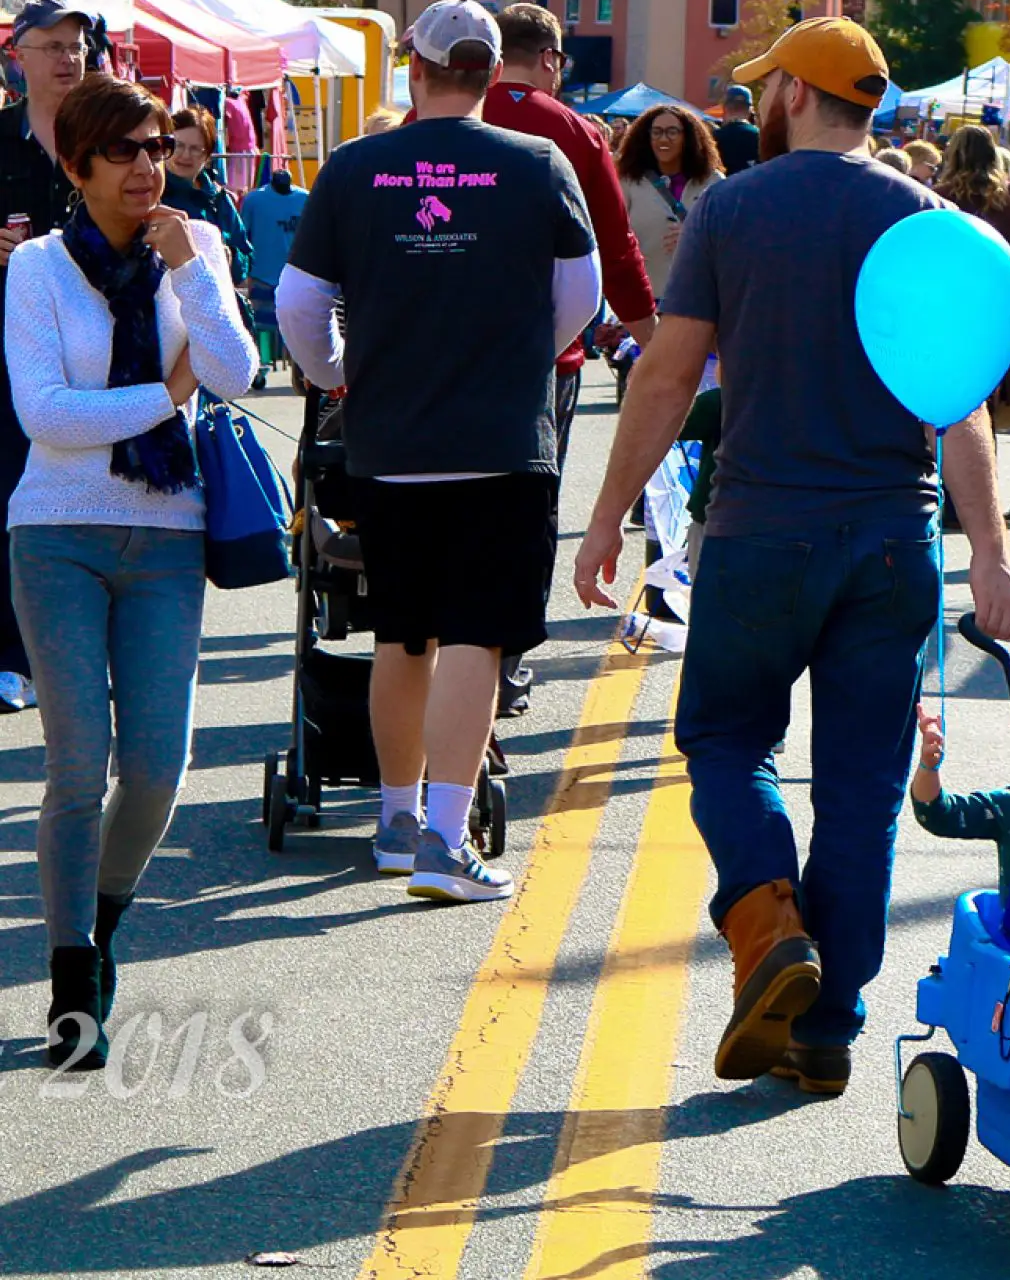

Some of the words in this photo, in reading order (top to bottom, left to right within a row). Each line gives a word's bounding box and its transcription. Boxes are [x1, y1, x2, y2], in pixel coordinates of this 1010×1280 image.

[416, 161, 433, 173] We
[436, 164, 455, 174] are
[373, 173, 413, 188] More
[416, 174, 455, 188] Than
[458, 172, 498, 188] PINK
[394, 234, 424, 242] WILSON
[426, 234, 433, 242] &
[434, 232, 478, 241] ASSOCIATES
